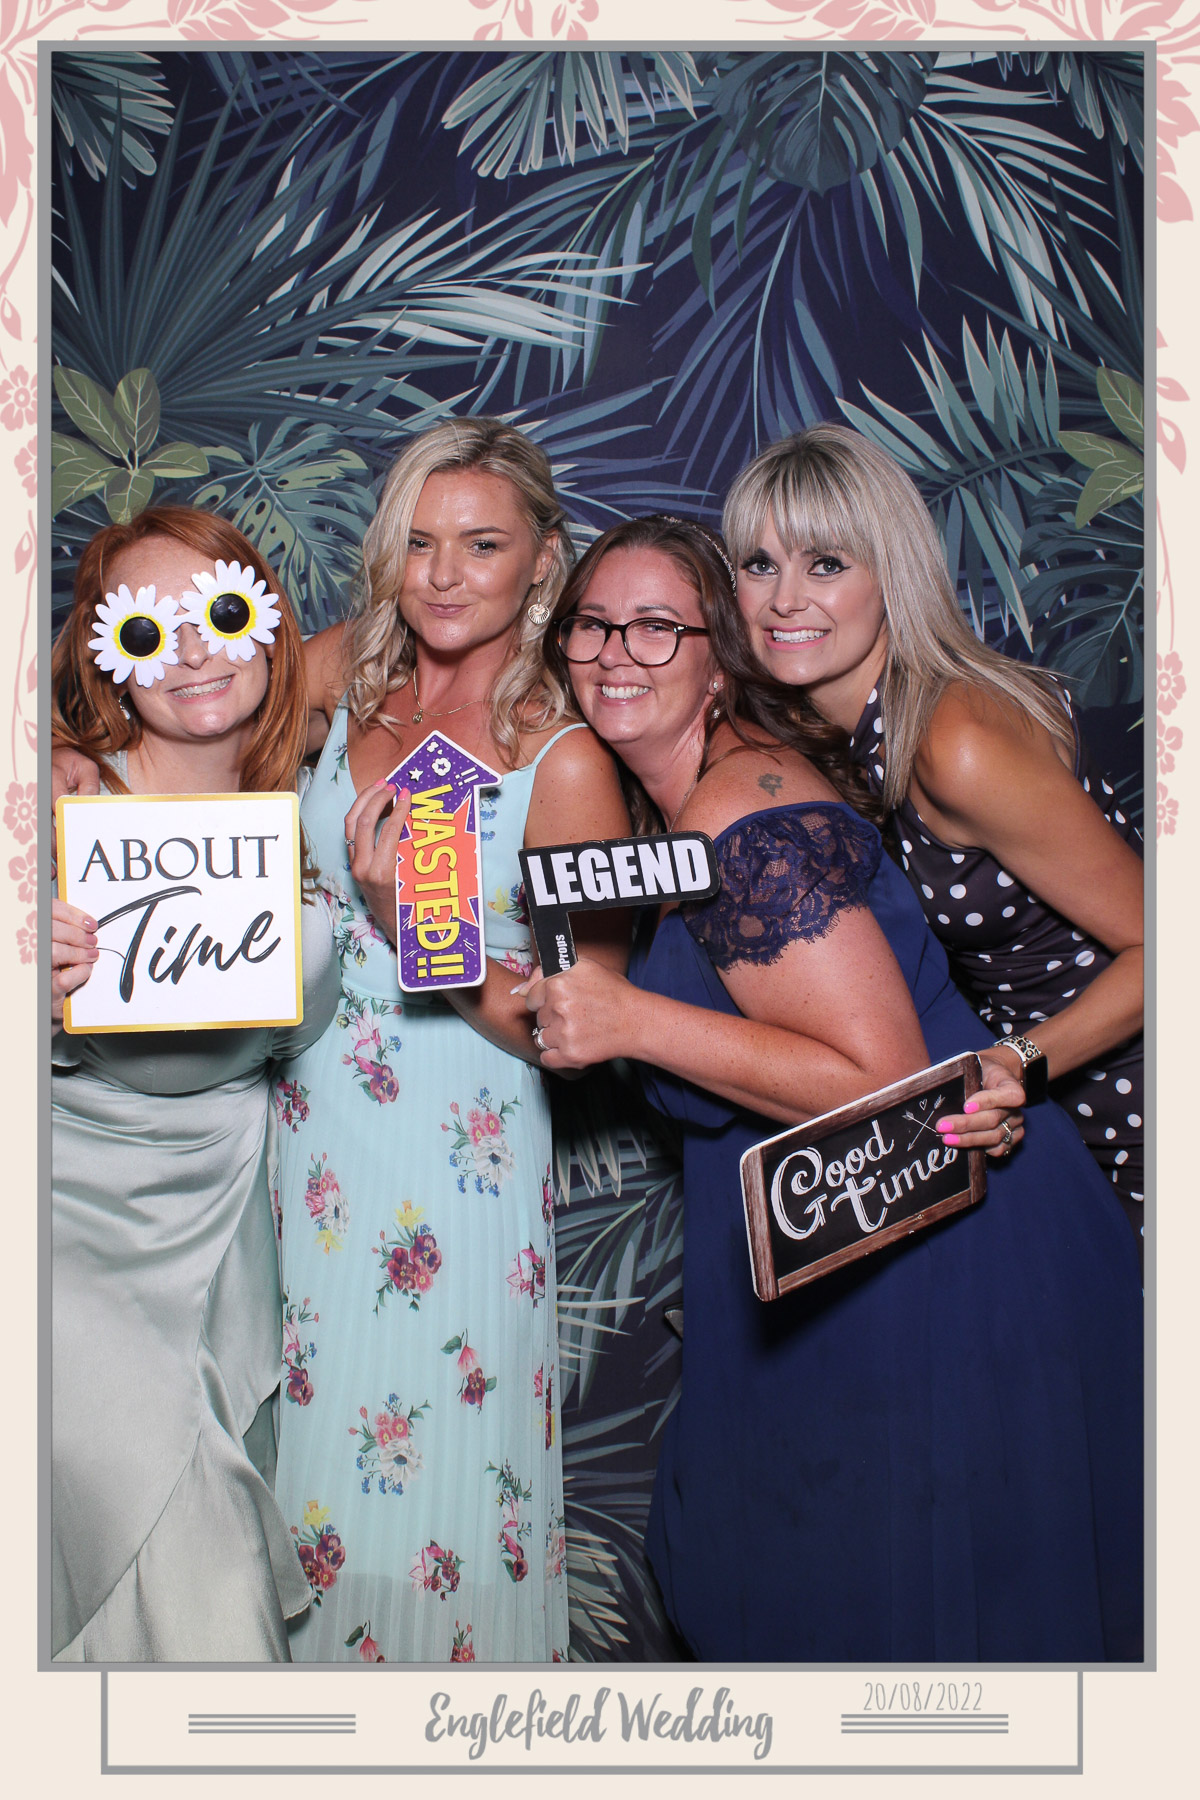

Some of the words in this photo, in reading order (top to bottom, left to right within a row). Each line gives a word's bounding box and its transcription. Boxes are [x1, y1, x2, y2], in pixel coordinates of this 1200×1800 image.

[78, 834, 279, 883] ABOUT
[411, 783, 465, 978] WASTED!!
[526, 839, 712, 907] LEGEND
[96, 885, 282, 1004] Time
[770, 1119, 895, 1241] Good
